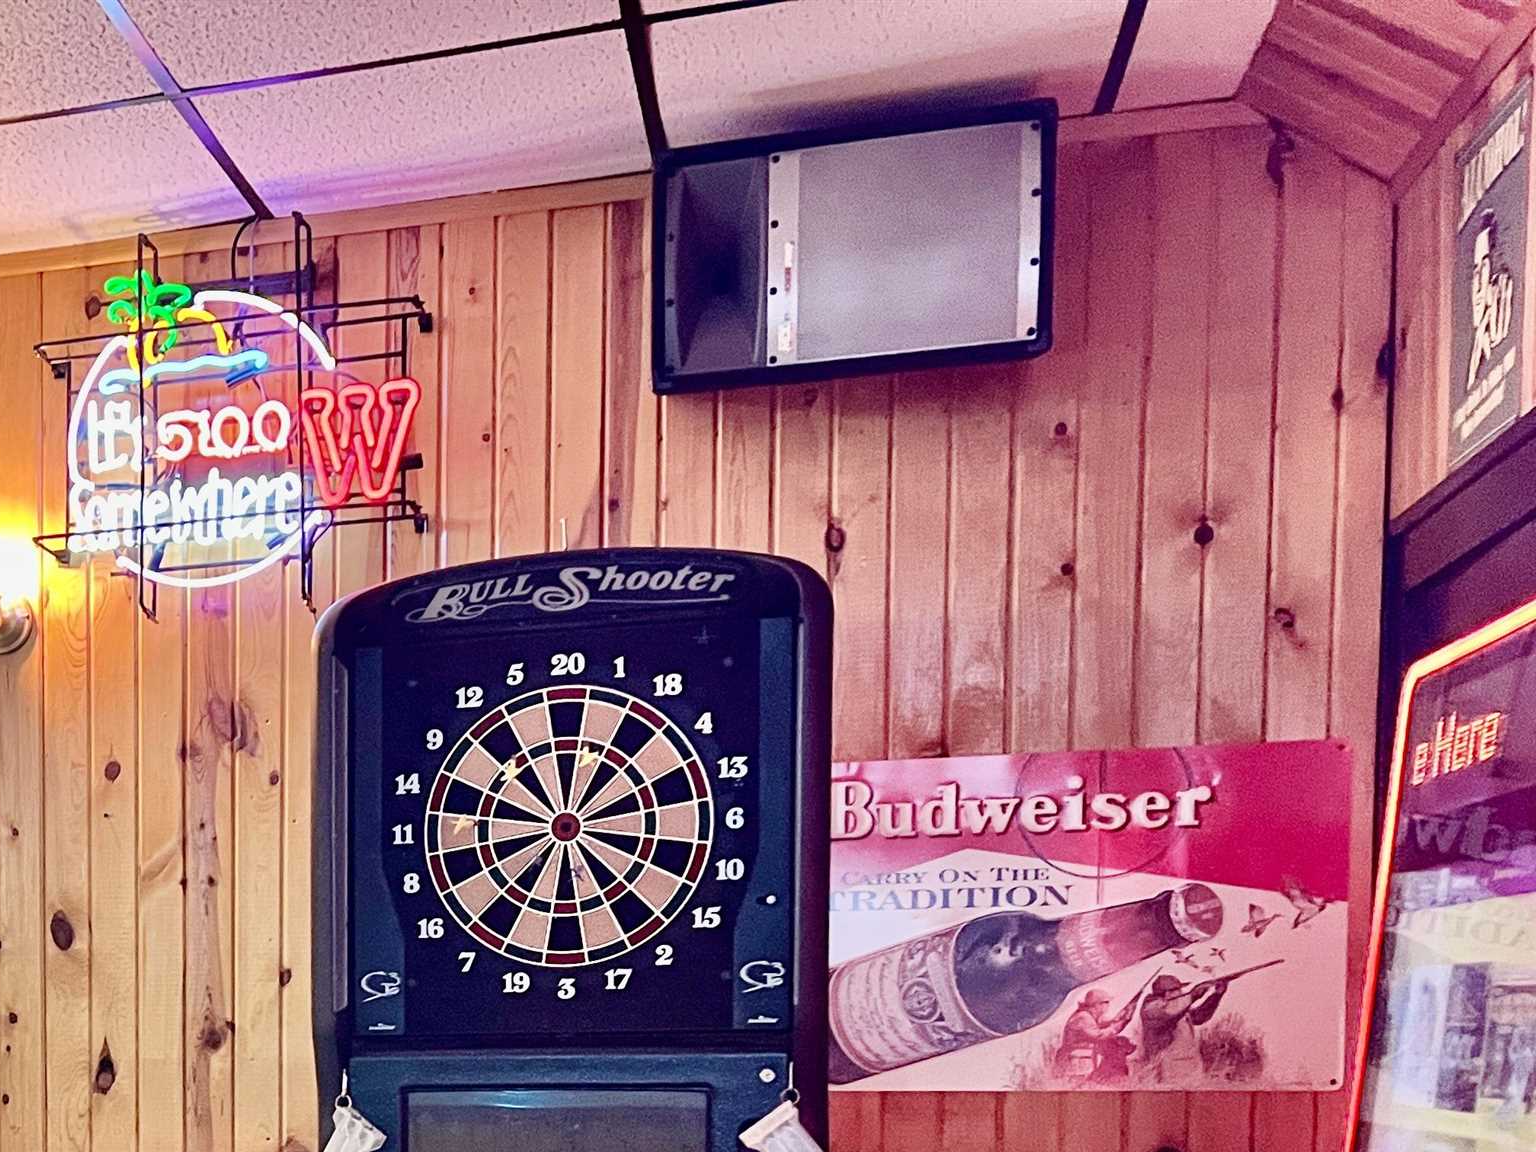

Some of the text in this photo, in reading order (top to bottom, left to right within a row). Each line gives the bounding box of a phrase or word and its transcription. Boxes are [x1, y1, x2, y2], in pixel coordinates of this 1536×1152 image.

[301, 378, 421, 509] W
[414, 573, 534, 621] BULL
[506, 662, 524, 686] 5
[550, 652, 586, 676] 20
[613, 655, 626, 679] 1
[652, 673, 683, 697] 18
[455, 686, 484, 709] 12
[694, 711, 713, 735] 4
[426, 728, 444, 751] 9
[716, 756, 749, 779] 13
[394, 773, 421, 796] 14
[725, 806, 745, 829] 6
[830, 775, 1219, 841] Budweiser
[391, 823, 415, 845] 11
[715, 858, 745, 881] 10
[403, 872, 421, 894] 8
[830, 883, 1075, 913] TRADITION
[417, 917, 444, 939] 16
[692, 906, 722, 929] 15
[457, 951, 476, 973] 7
[654, 944, 674, 966] 2
[502, 971, 531, 994] 19
[557, 977, 576, 1000] 3
[604, 968, 633, 990] 17
